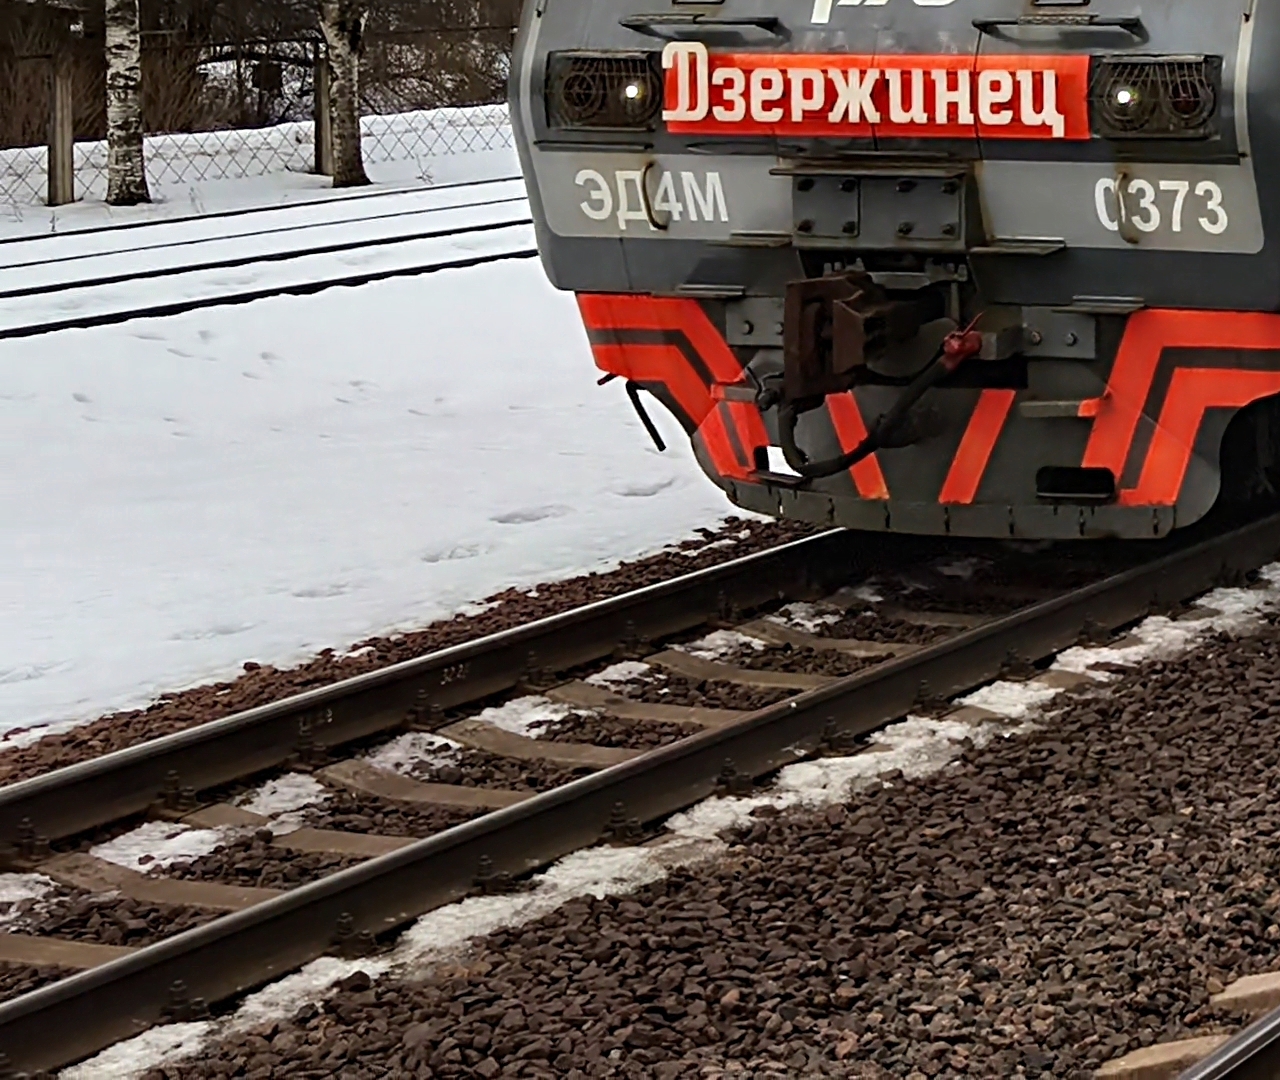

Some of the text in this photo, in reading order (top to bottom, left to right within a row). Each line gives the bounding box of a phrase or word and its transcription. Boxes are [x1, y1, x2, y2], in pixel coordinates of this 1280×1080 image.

[662, 41, 1064, 138] Дзержинец
[575, 169, 729, 231] ЭД4М
[1095, 178, 1228, 235] 0373
